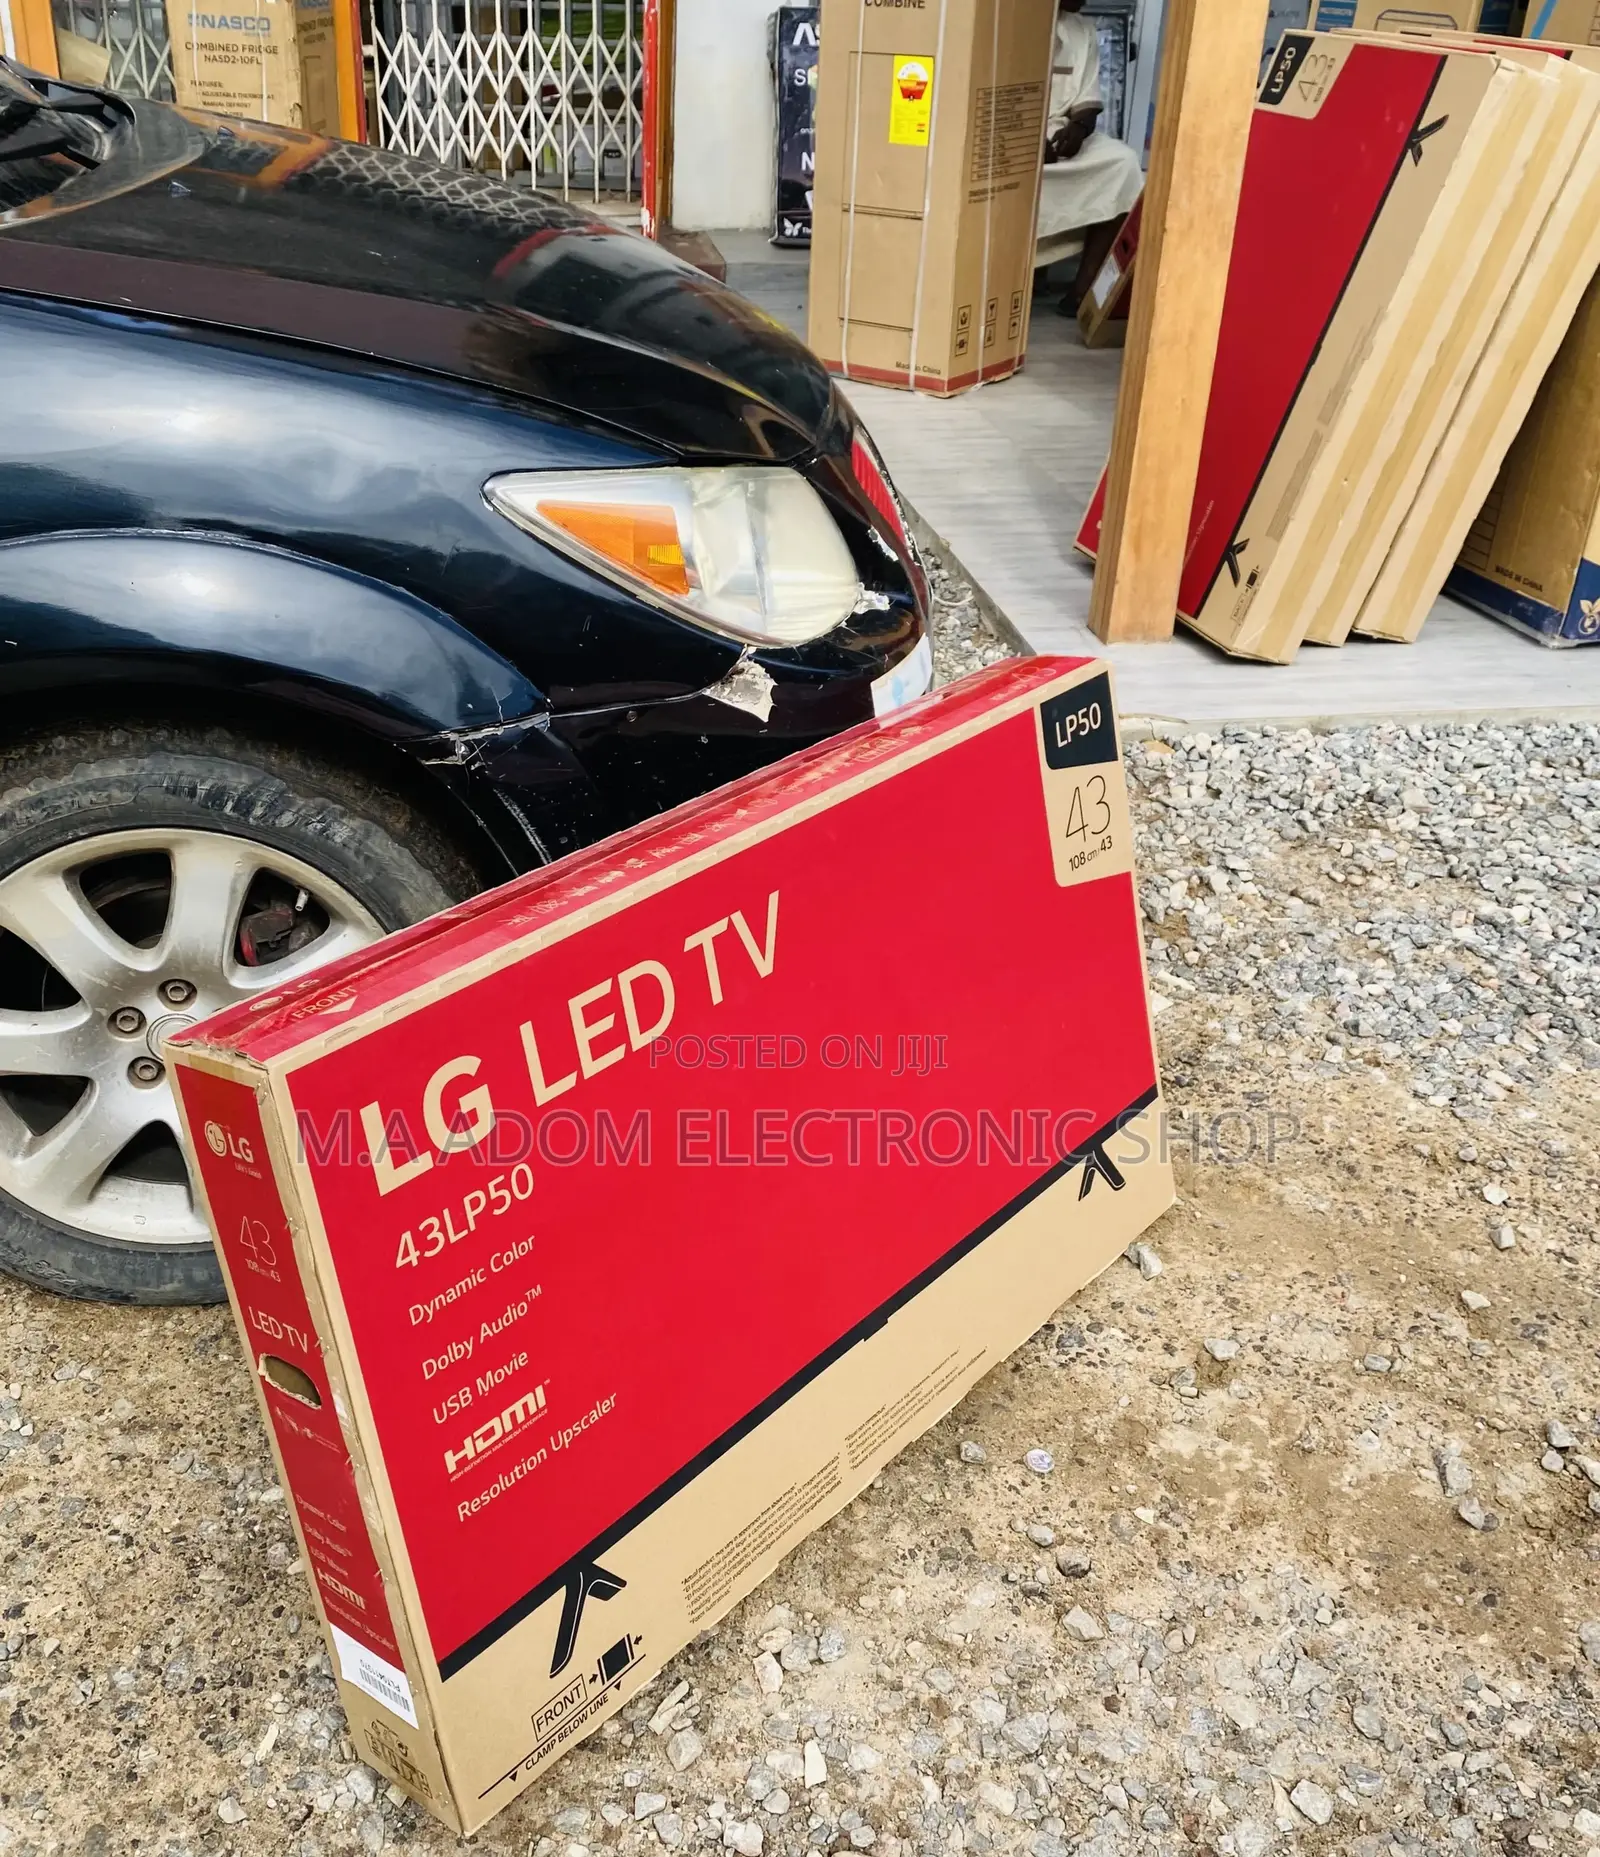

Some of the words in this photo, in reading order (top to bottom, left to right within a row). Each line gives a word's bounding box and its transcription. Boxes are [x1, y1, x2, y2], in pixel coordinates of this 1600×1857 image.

[201, 14, 271, 32] NASCO
[185, 41, 239, 54] COMBINED
[1270, 47, 1297, 93] LP50
[238, 92, 275, 101] THERMOSAT
[1298, 54, 1329, 102] 43
[895, 360, 911, 370] Mad
[1056, 702, 1102, 748] LP50
[1065, 775, 1111, 843] 43
[1069, 851, 1086, 871] 108
[291, 986, 358, 1019] FRONT
[359, 1054, 497, 1197] LG
[519, 959, 676, 1108] LED
[683, 889, 780, 1007] TV
[227, 1132, 254, 1164] LG
[395, 1162, 535, 1270] 43LP50
[240, 1215, 277, 1266] 43
[408, 1267, 487, 1326] Dynamic
[490, 1235, 535, 1273] Color
[249, 1305, 283, 1340] LED
[283, 1322, 308, 1354] TV
[421, 1336, 474, 1381] Dolby
[432, 1386, 473, 1424] USB
[475, 1350, 529, 1397] Movie
[443, 1384, 547, 1475] HDMI
[457, 1447, 548, 1522] Resolution
[549, 1392, 617, 1452] Upscaler
[316, 1566, 366, 1611] HDMI
[525, 1739, 557, 1771] CLAMP
[557, 1710, 589, 1744] BELOW
[589, 1692, 610, 1716] LINE
[535, 1683, 583, 1733] FRONT
